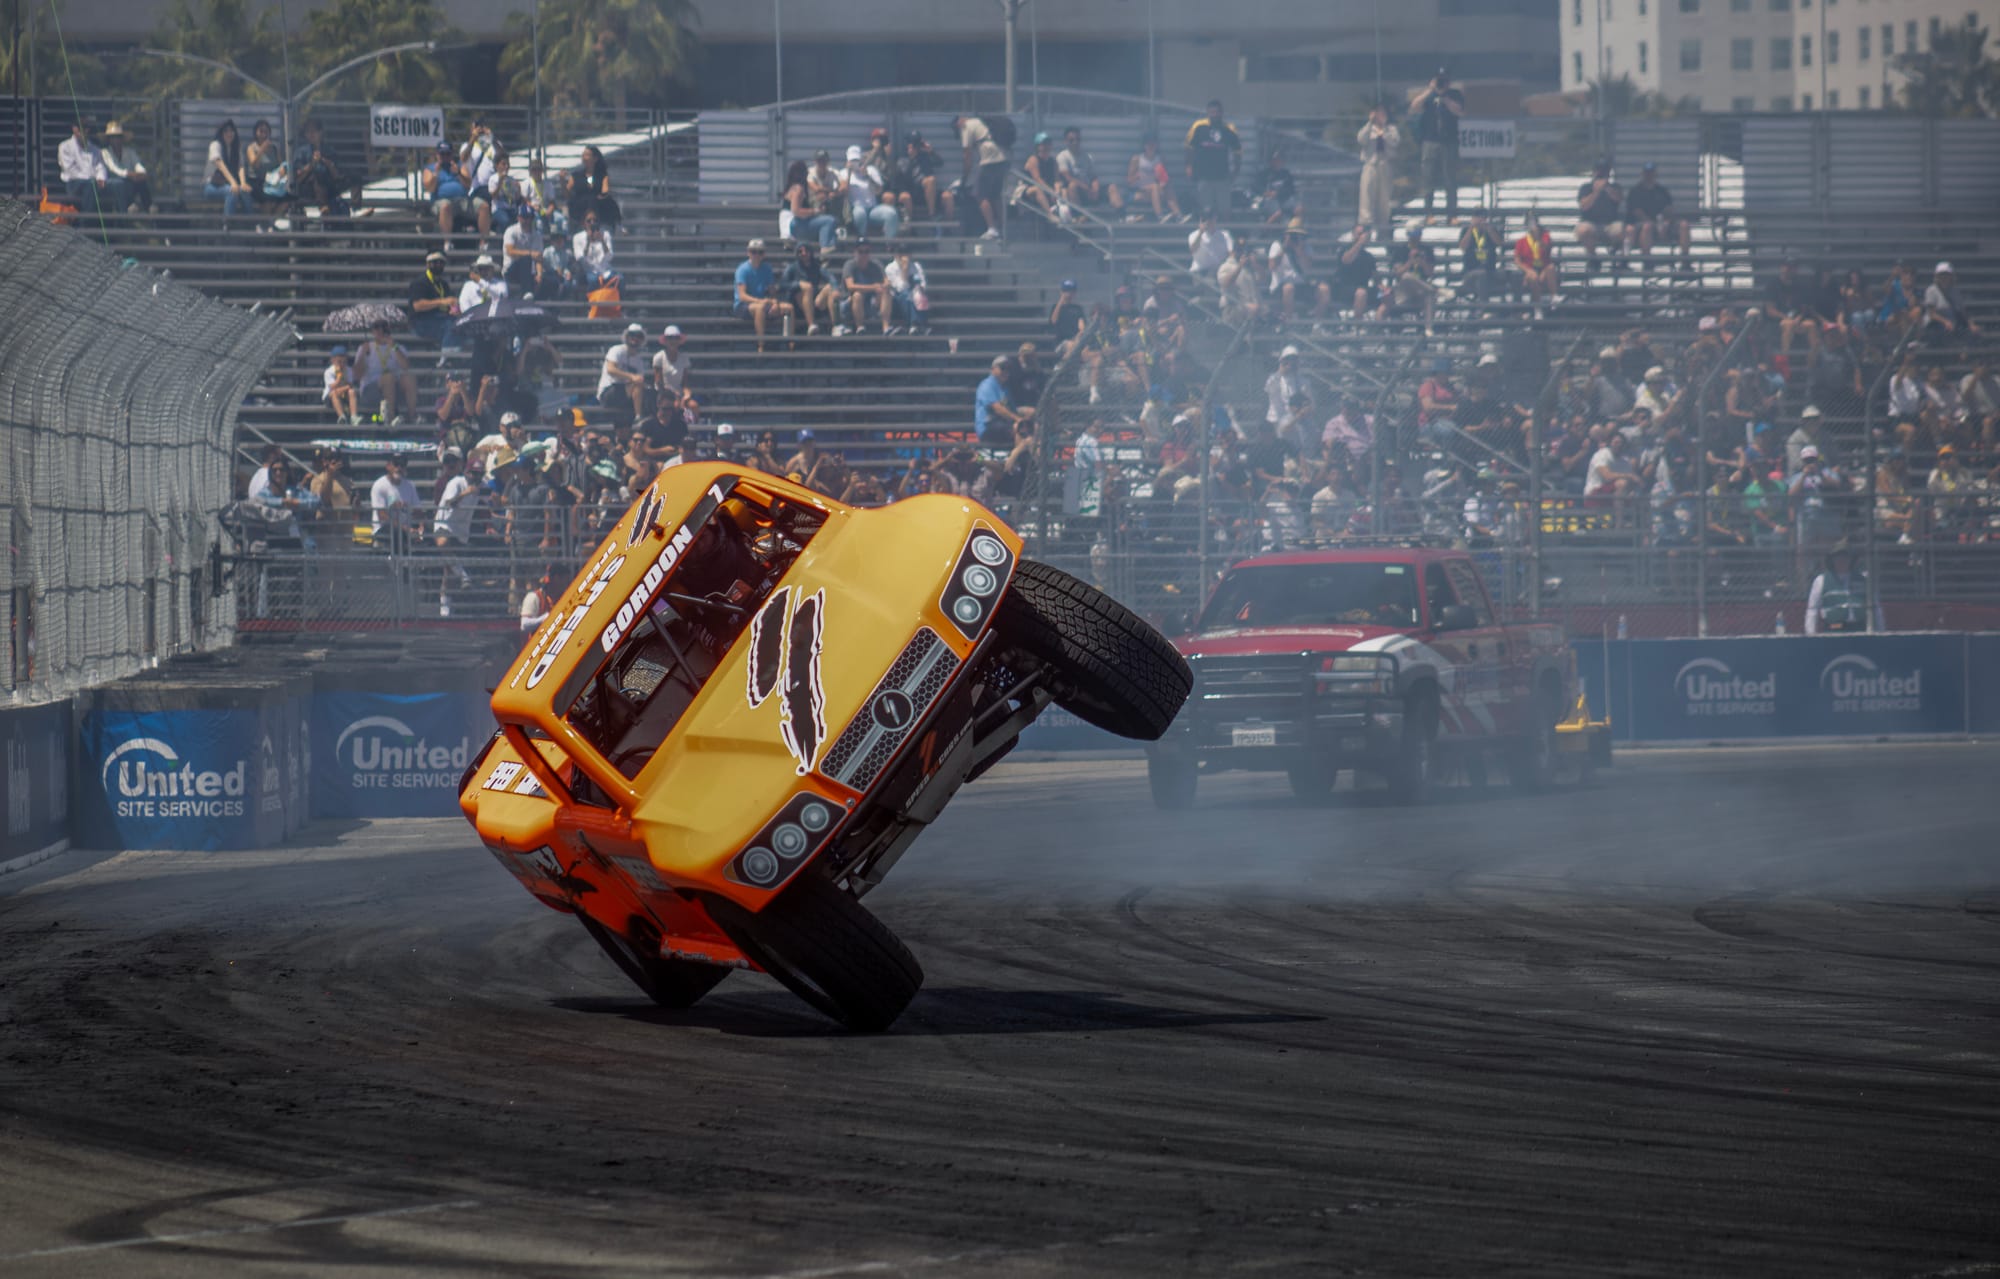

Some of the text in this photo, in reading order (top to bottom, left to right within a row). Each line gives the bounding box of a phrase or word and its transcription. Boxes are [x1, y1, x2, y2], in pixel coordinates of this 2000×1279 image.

[374, 115, 441, 137] SECTION 2
[1460, 128, 1504, 148] ECTION
[600, 524, 694, 654] GORDON
[526, 553, 628, 691] SPEED
[1686, 671, 1777, 700] United
[1831, 669, 1921, 697] United
[1686, 700, 1776, 715] SITE SERVICES
[352, 736, 469, 771] United
[119, 760, 247, 797] United
[352, 773, 388, 788] SITE
[392, 772, 463, 789] SERVICE
[117, 800, 244, 817] SITE SERVICES
